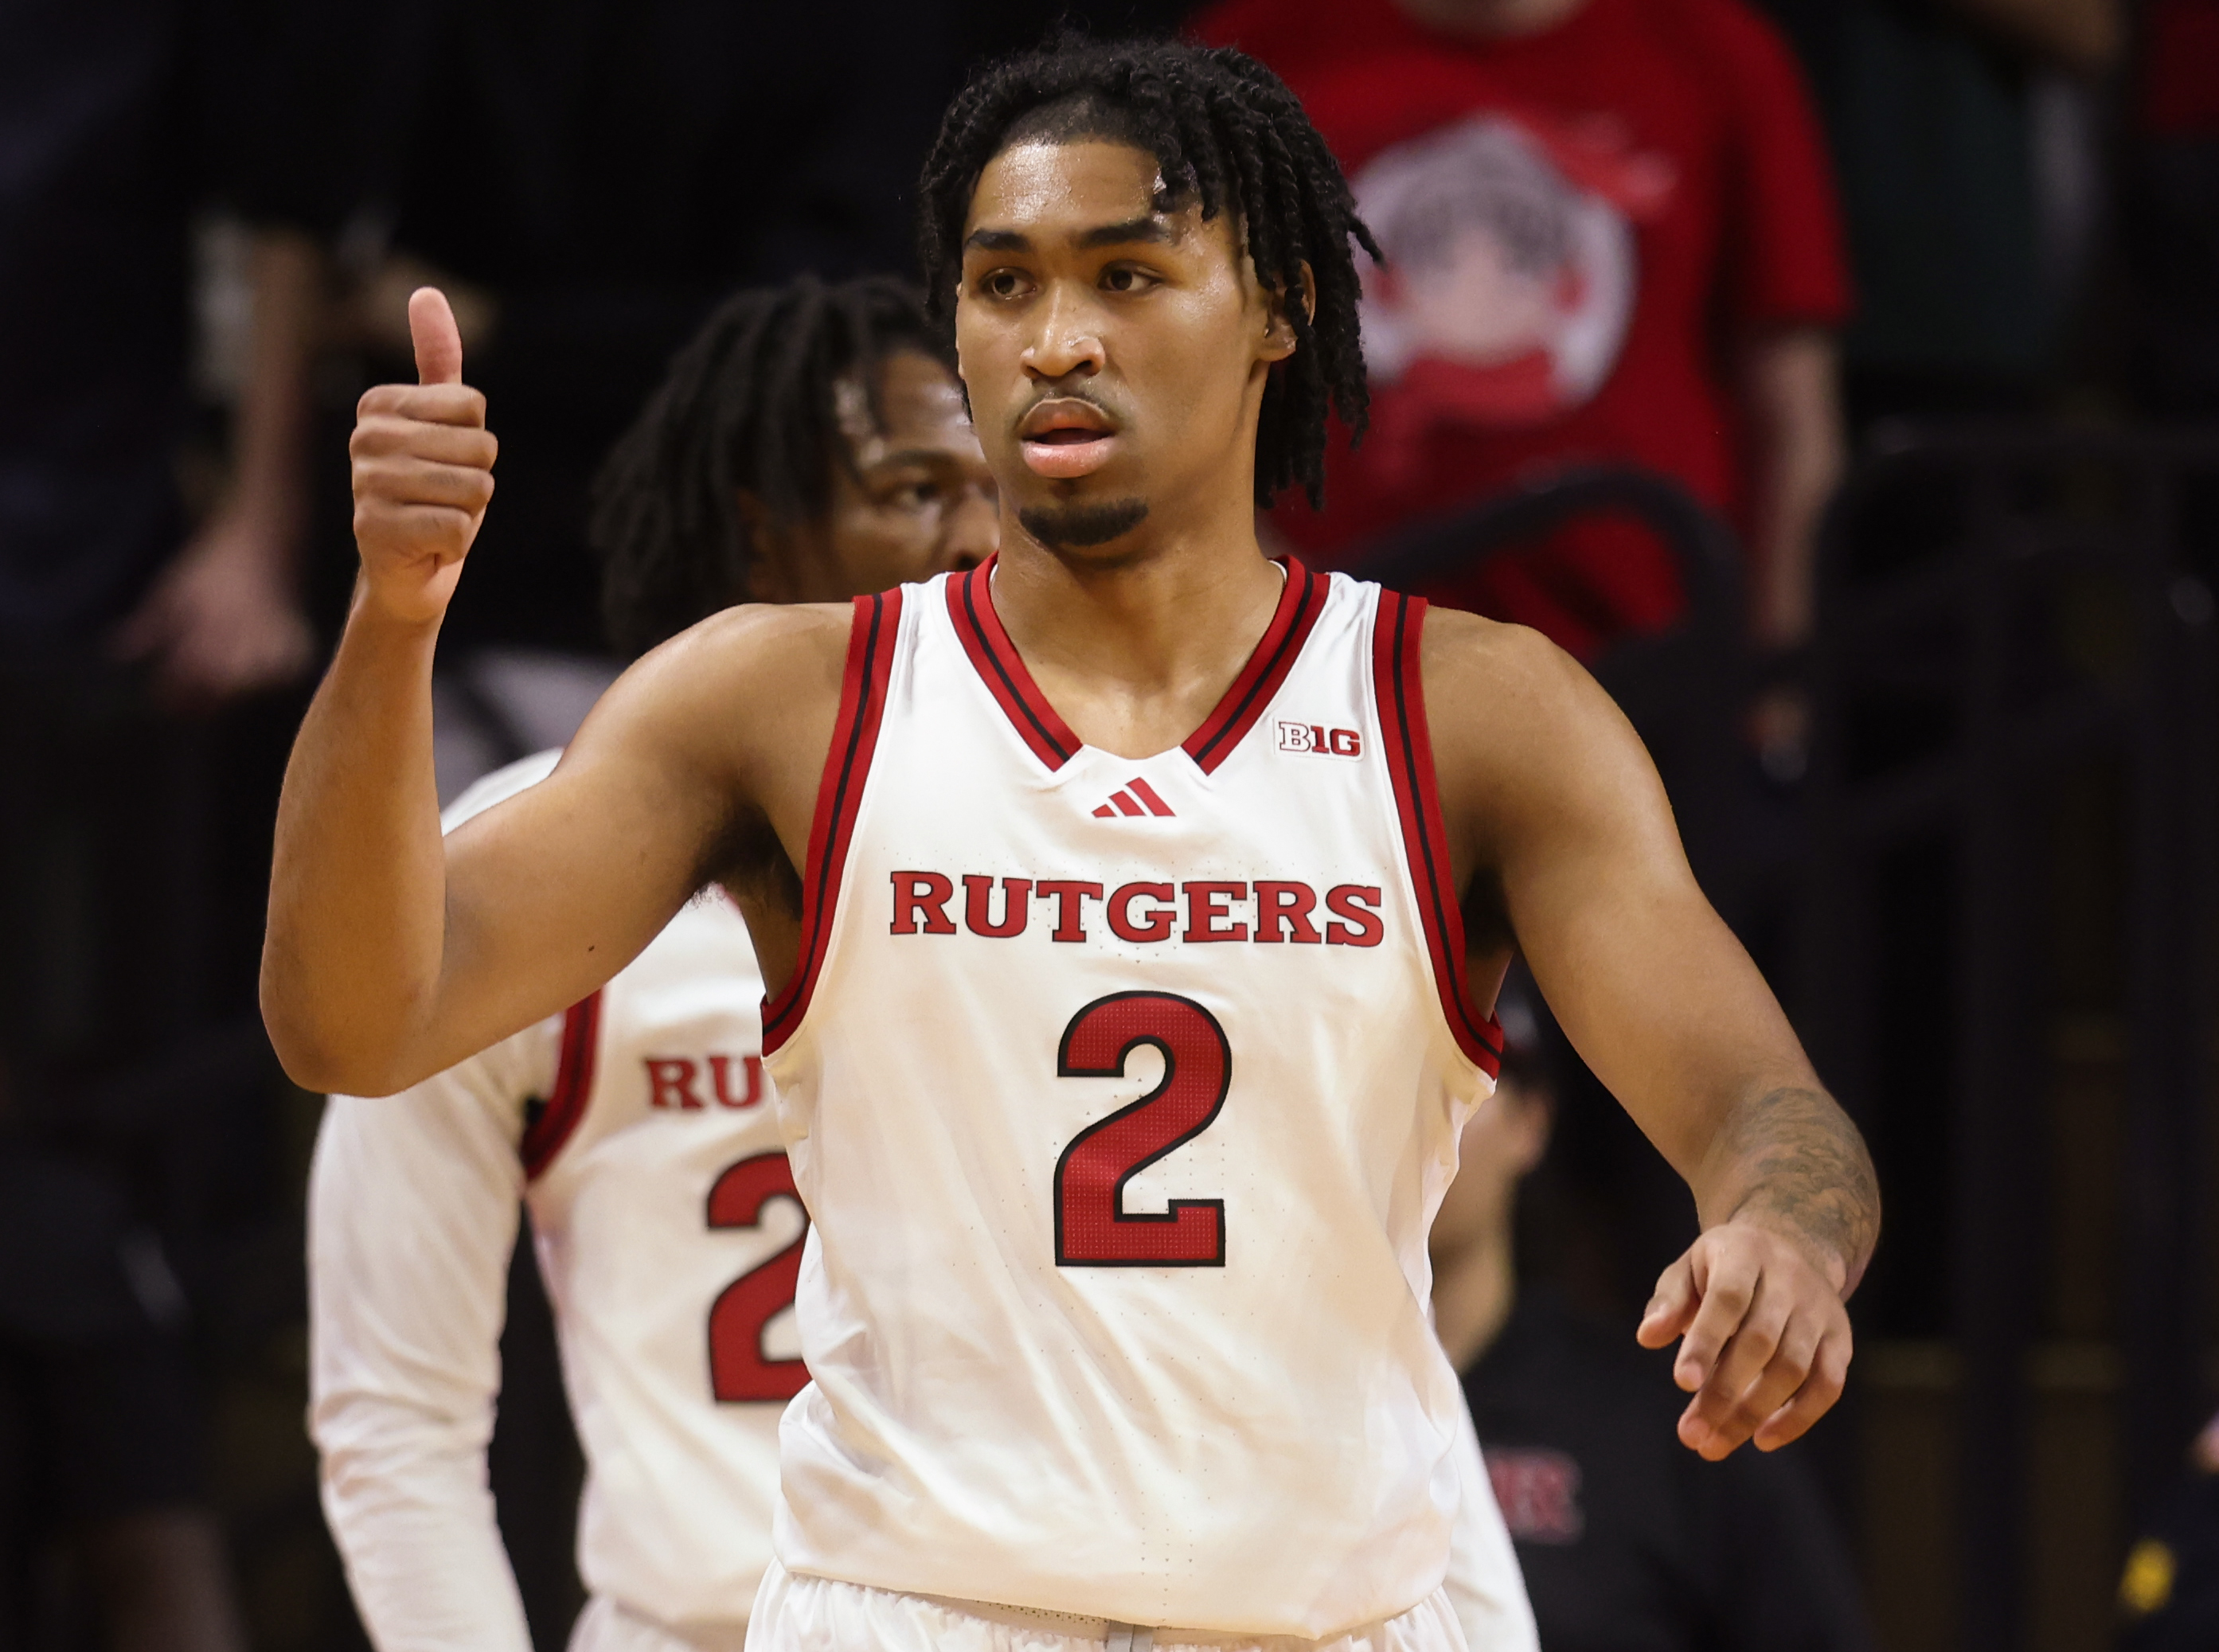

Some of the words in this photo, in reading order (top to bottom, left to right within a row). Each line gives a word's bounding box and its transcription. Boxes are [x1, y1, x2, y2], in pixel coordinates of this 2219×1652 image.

[890, 870, 1384, 947] RUTGERS
[1054, 990, 1232, 1267] 2
[705, 1151, 814, 1403] 2
